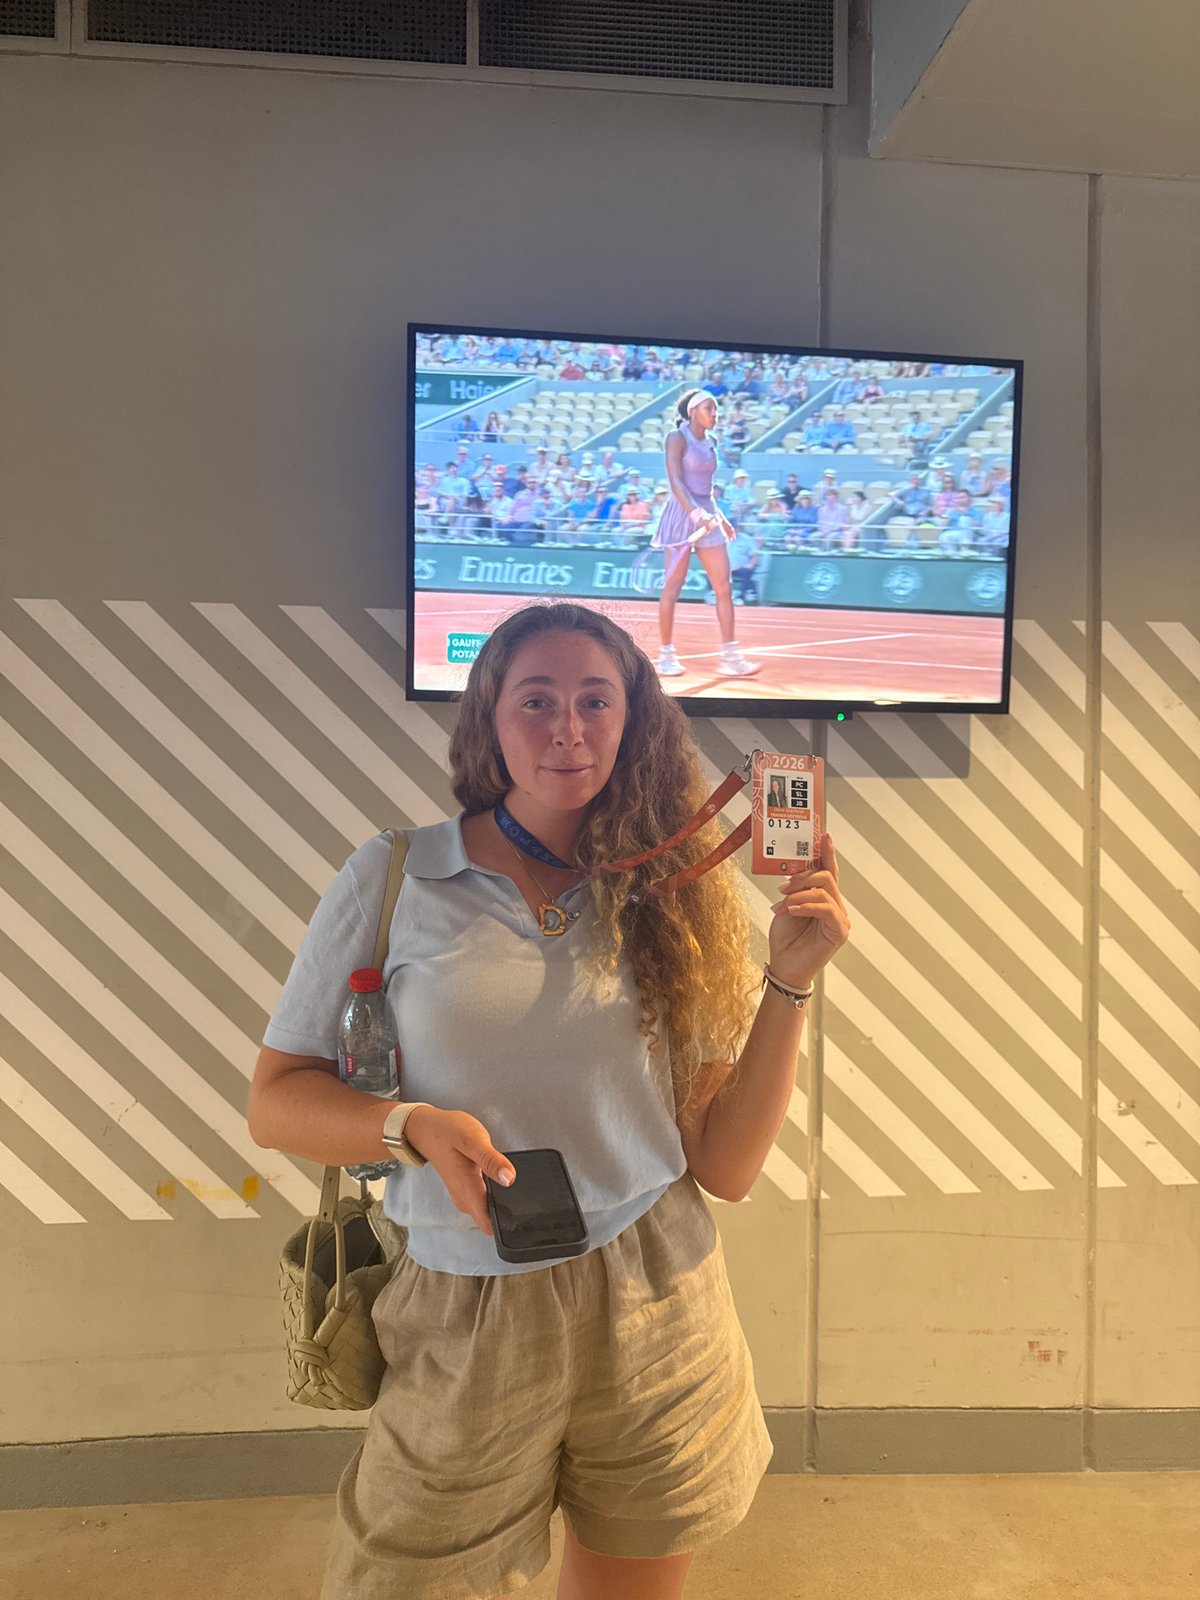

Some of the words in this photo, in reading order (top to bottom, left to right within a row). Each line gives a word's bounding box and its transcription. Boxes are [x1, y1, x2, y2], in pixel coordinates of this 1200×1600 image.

[451, 379, 502, 399] Haie
[458, 555, 574, 586] Emirates
[772, 755, 805, 770] 2026
